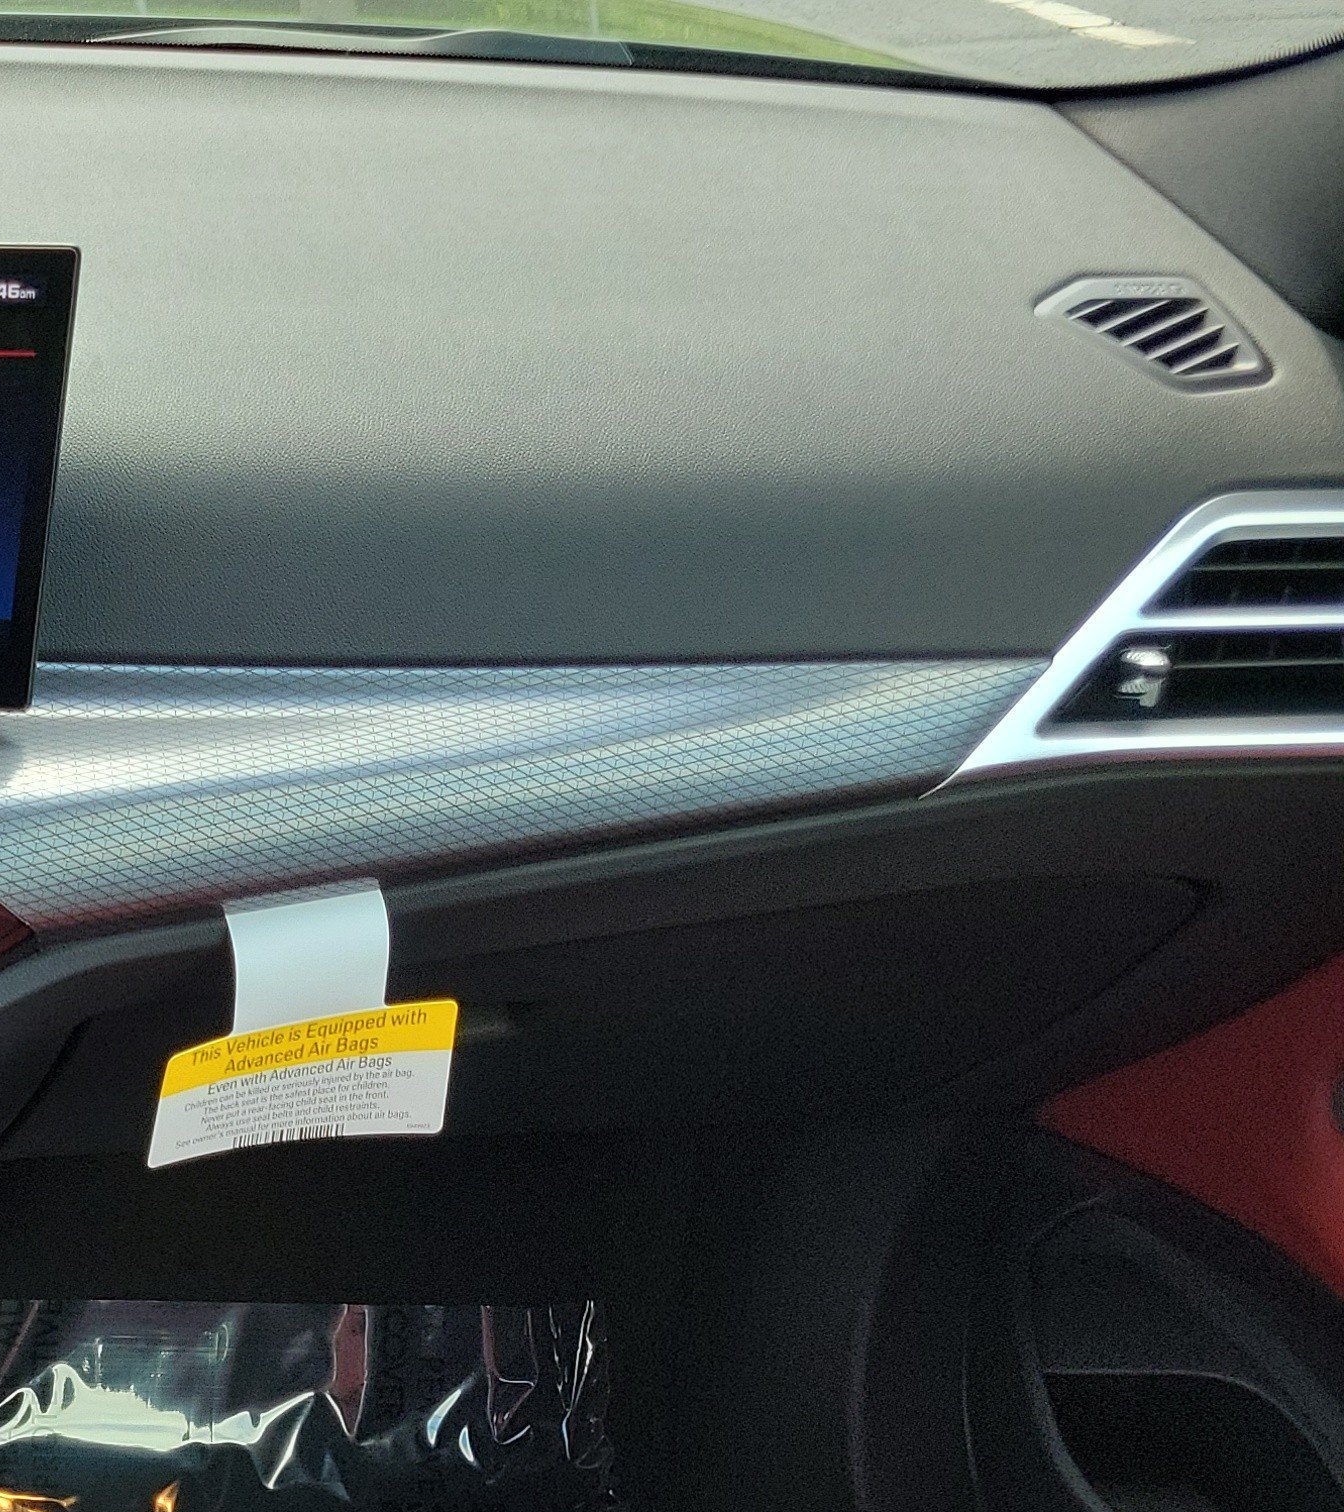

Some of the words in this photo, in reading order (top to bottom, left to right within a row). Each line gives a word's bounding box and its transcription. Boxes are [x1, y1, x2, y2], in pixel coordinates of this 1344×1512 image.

[192, 1046, 222, 1066] This
[226, 1030, 284, 1055] Vehicle
[288, 1027, 301, 1042] is
[306, 1012, 387, 1039] Equipped
[392, 1008, 427, 1027] with
[224, 1044, 305, 1074] Advanced
[308, 1040, 330, 1058] Air
[336, 1036, 379, 1055] Bags
[207, 1081, 238, 1095] Even
[240, 1072, 267, 1087] with
[269, 1059, 333, 1081] Advanced
[336, 1057, 355, 1072] Air
[358, 1056, 392, 1071] Bags
[337, 1083, 350, 1093] for
[354, 1072, 365, 1083] by
[365, 1070, 380, 1080] the
[382, 1069, 393, 1078] air
[395, 1068, 415, 1079] bag.
[349, 1091, 365, 1101] the
